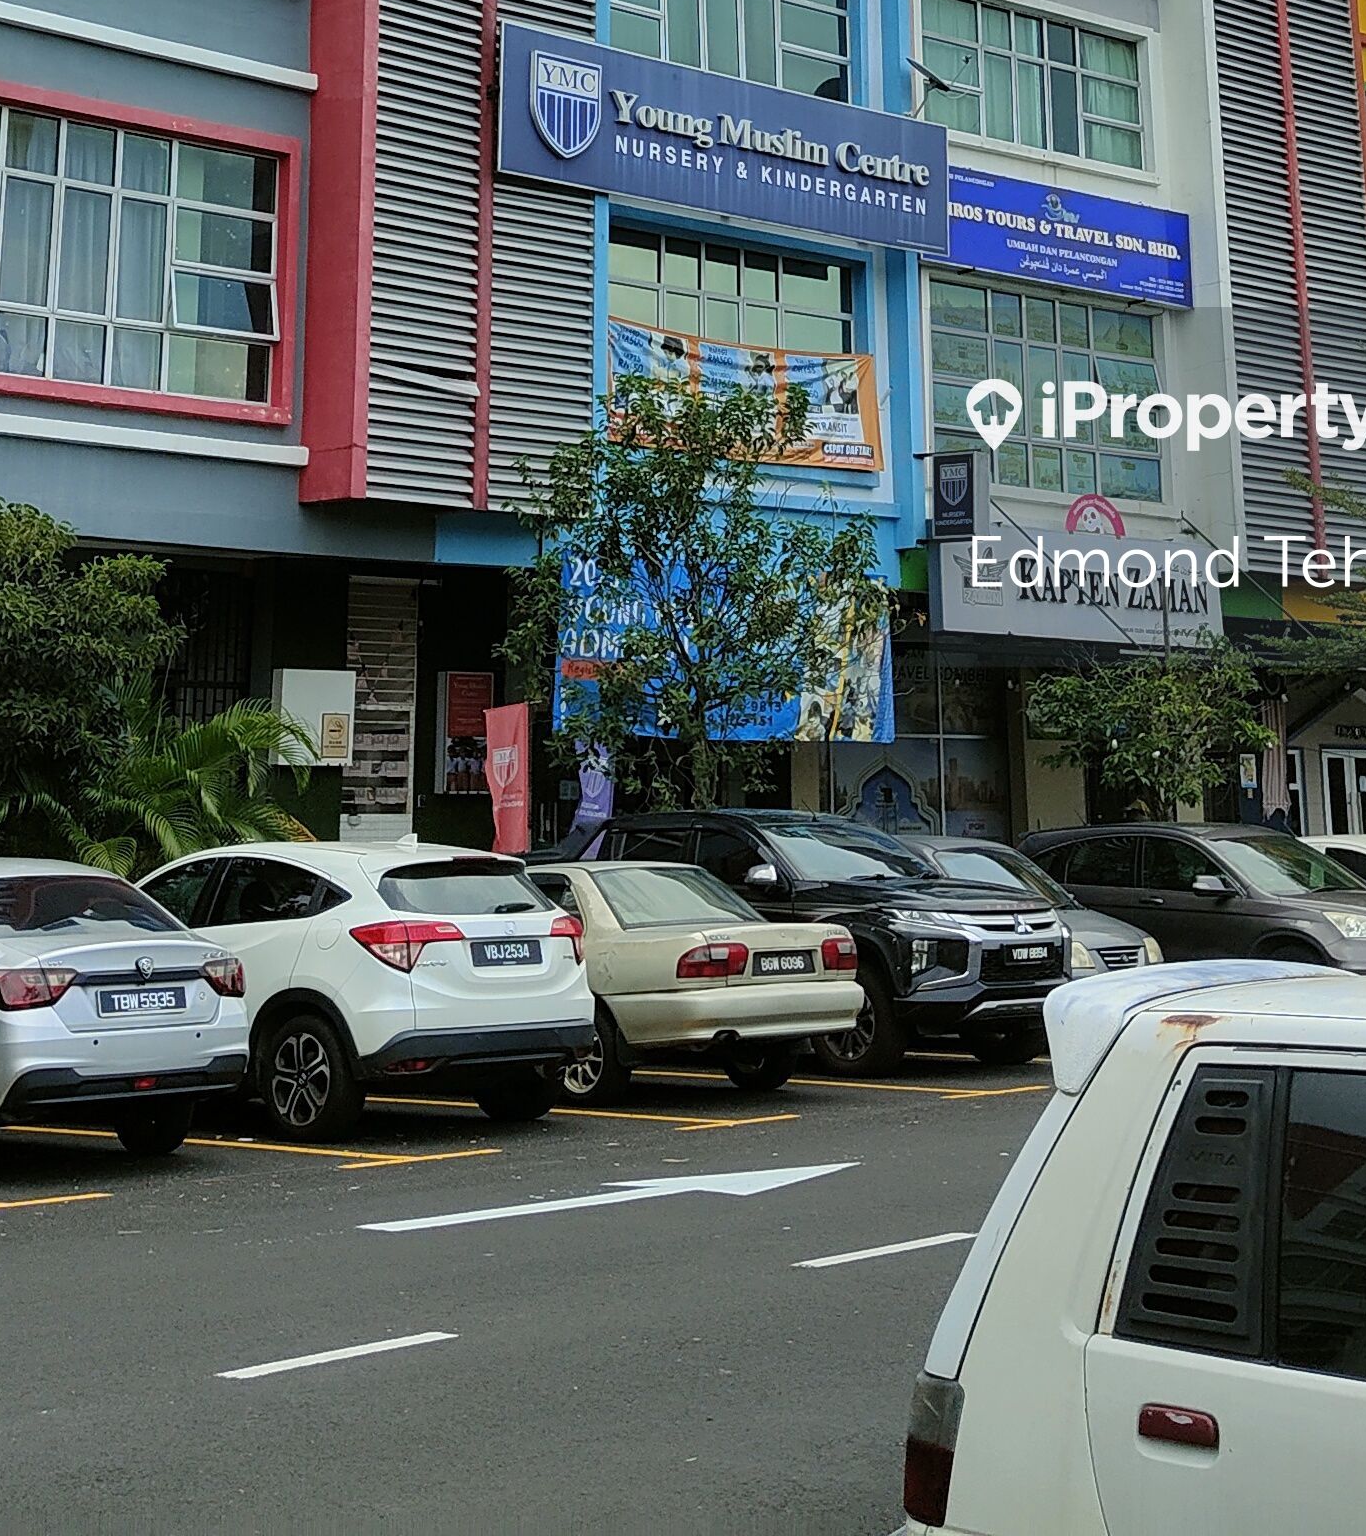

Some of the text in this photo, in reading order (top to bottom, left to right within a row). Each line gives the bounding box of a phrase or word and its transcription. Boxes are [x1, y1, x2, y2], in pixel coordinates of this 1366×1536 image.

[540, 62, 596, 93] YMC
[609, 89, 930, 186] Young Muslim Centre
[615, 135, 927, 216] NURSERY & KINDERGARTEN
[985, 208, 1035, 232] TOURS
[1039, 220, 1051, 235] &
[1054, 223, 1113, 247] TRAVEL
[1115, 234, 1146, 253] SDN.
[1147, 240, 1181, 261] BHD.
[1006, 238, 1118, 267] UMRAH DAN PELANCONGAN
[942, 467, 965, 477] YMC
[1018, 557, 1208, 615] KAPTEN ZAMAN
[760, 956, 805, 971] BGW 6096
